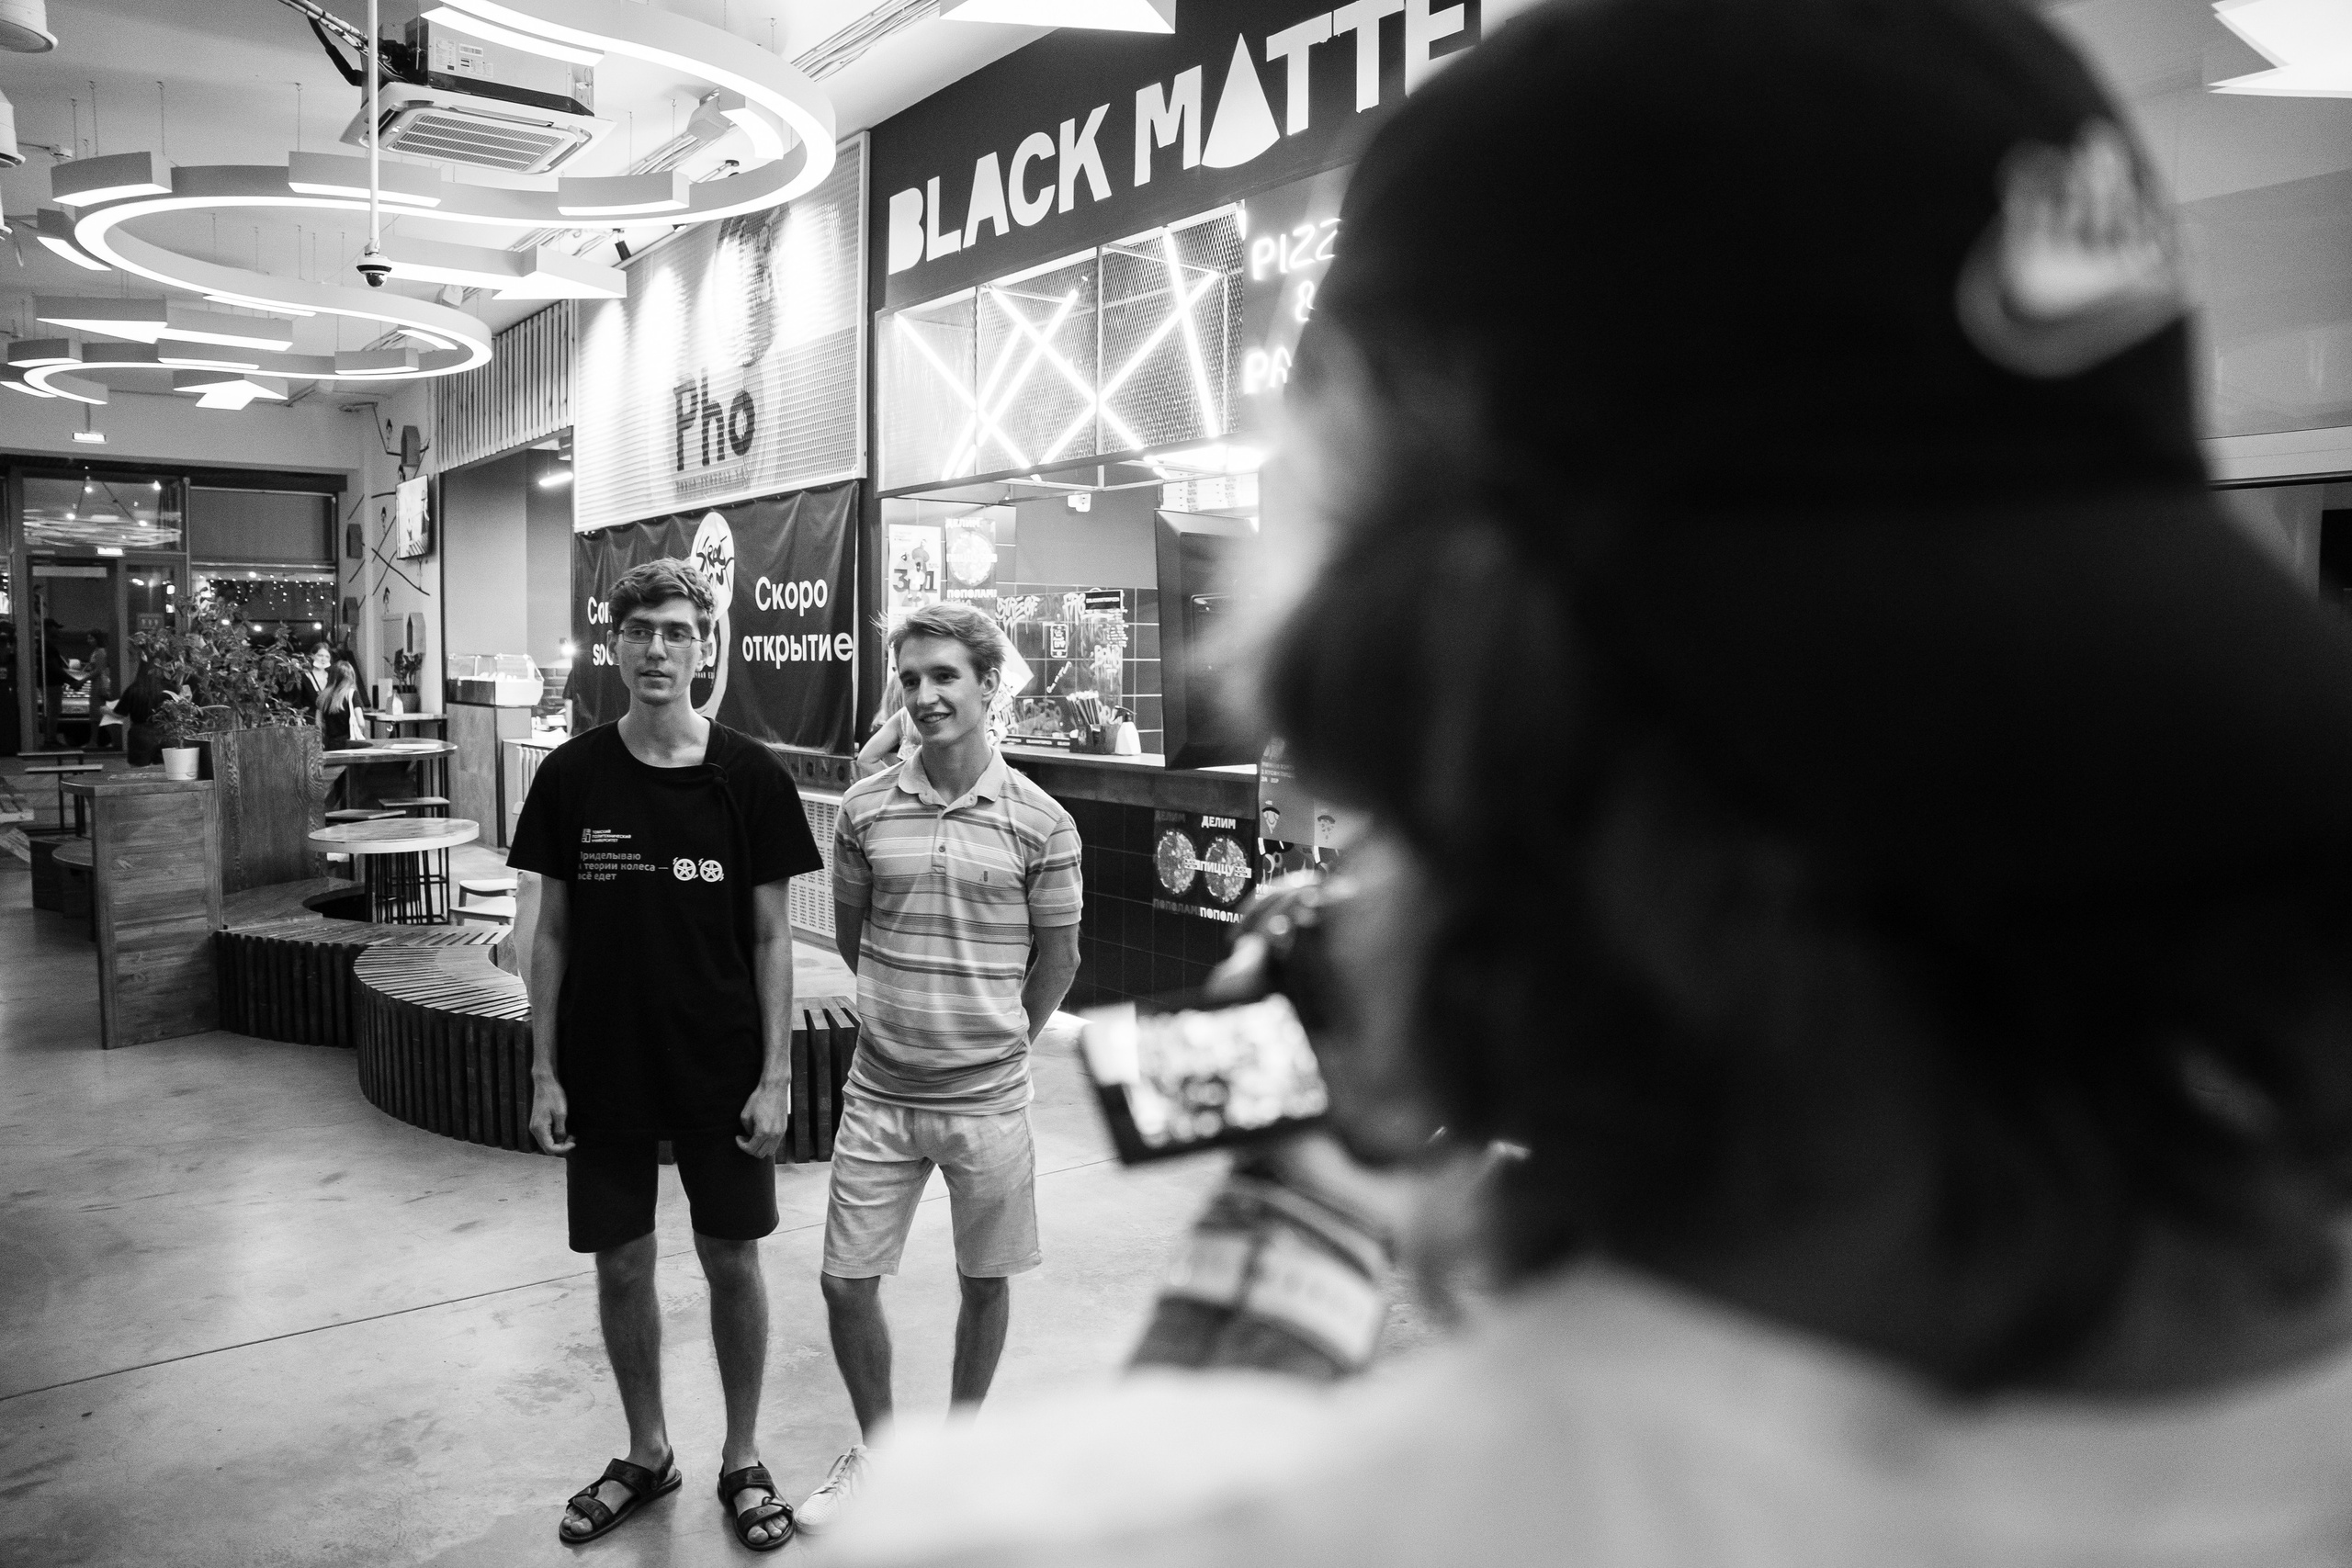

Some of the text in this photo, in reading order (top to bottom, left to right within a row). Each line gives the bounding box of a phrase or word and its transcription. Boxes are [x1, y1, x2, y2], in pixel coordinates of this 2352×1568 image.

[888, 0, 1536, 275] BLACK MATTE
[1251, 218, 1341, 281] PIZZ
[1295, 279, 1315, 322] &
[1244, 345, 1292, 395] PA
[673, 369, 756, 472] Pho
[755, 576, 828, 617] Скоро
[742, 632, 854, 670] открытие
[1201, 815, 1237, 830] ДЕЛИМ
[583, 863, 618, 872] теории
[620, 863, 656, 872] колеса
[594, 874, 617, 882] едет
[1200, 861, 1235, 877] ПИЦЦУ
